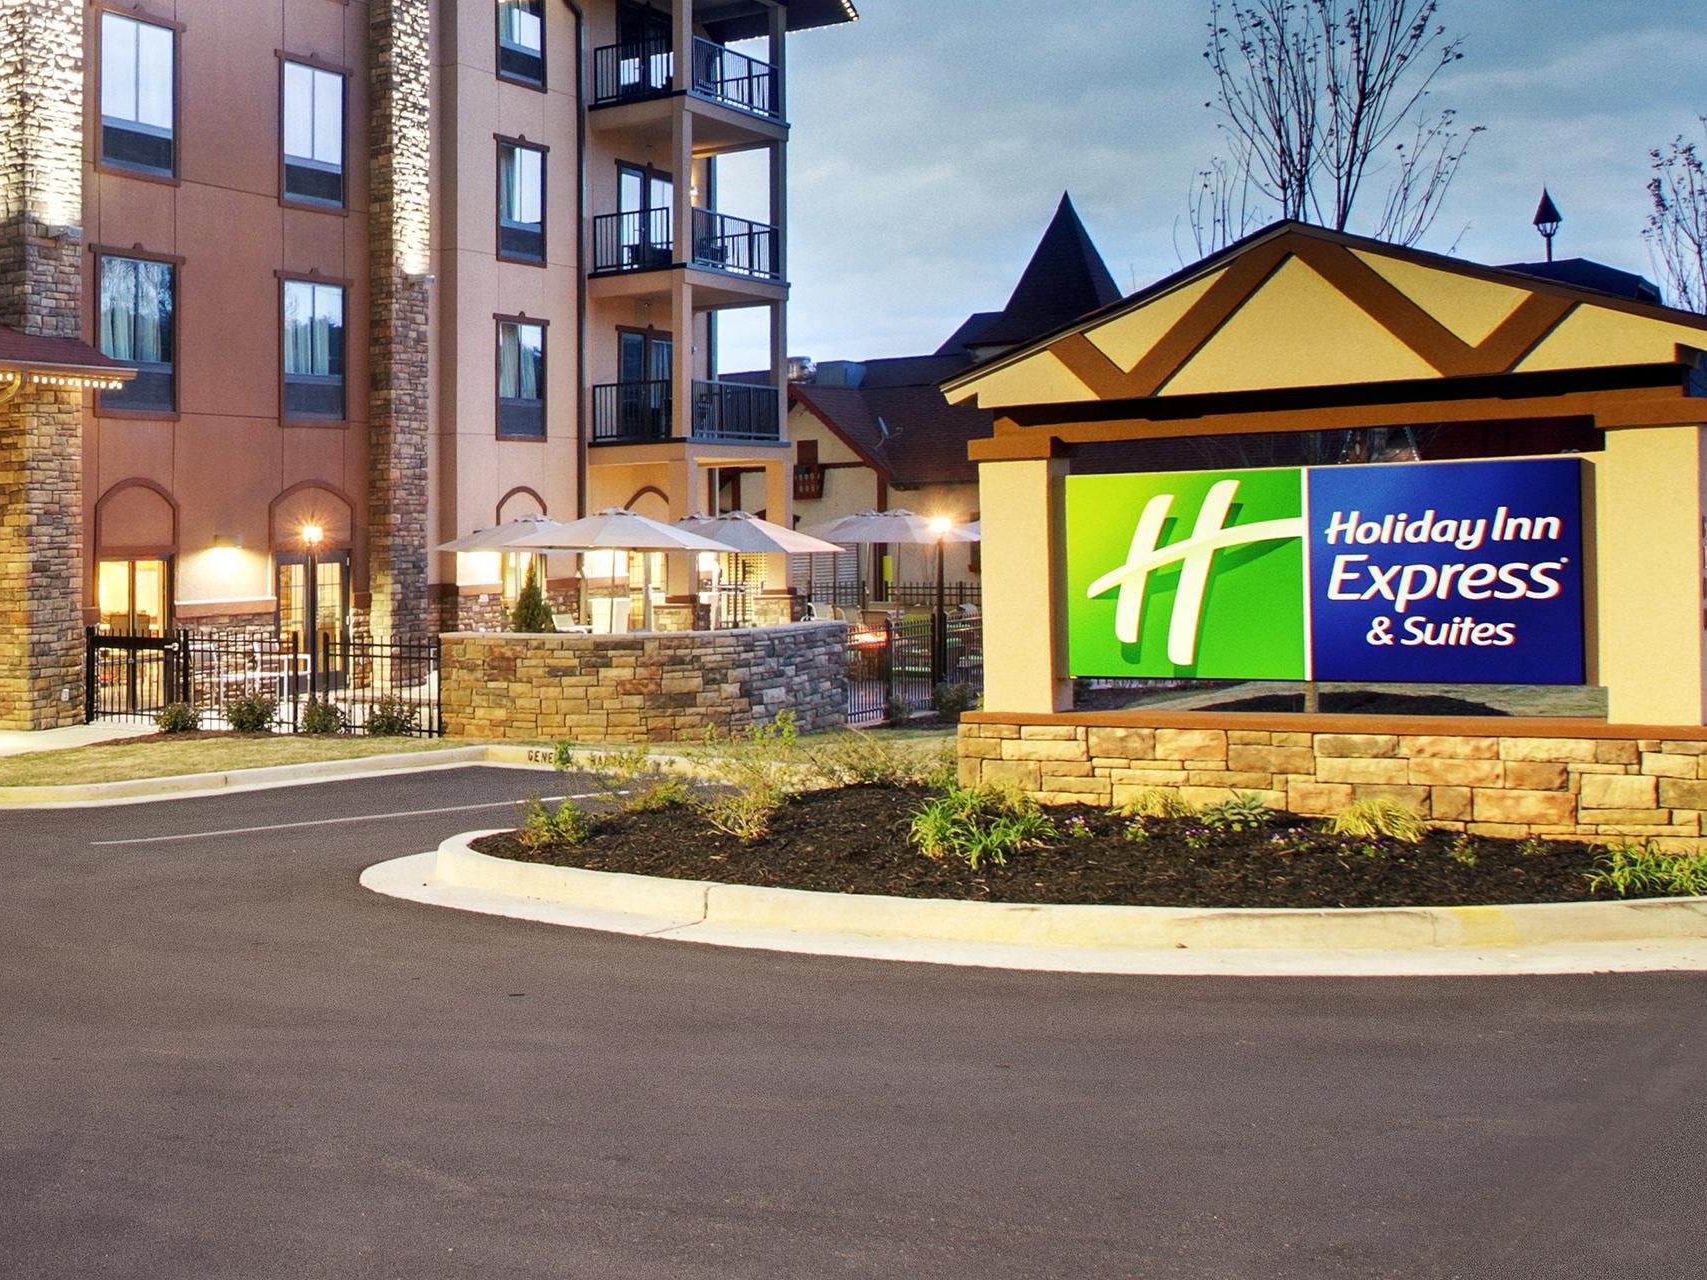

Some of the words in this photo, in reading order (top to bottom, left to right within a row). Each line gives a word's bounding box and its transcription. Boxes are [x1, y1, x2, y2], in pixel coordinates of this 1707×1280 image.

[1324, 510, 1486, 550] Holiday
[1491, 506, 1560, 542] Inn
[1326, 554, 1562, 613] Express
[1366, 617, 1394, 646] &
[1400, 616, 1516, 647] Suites
